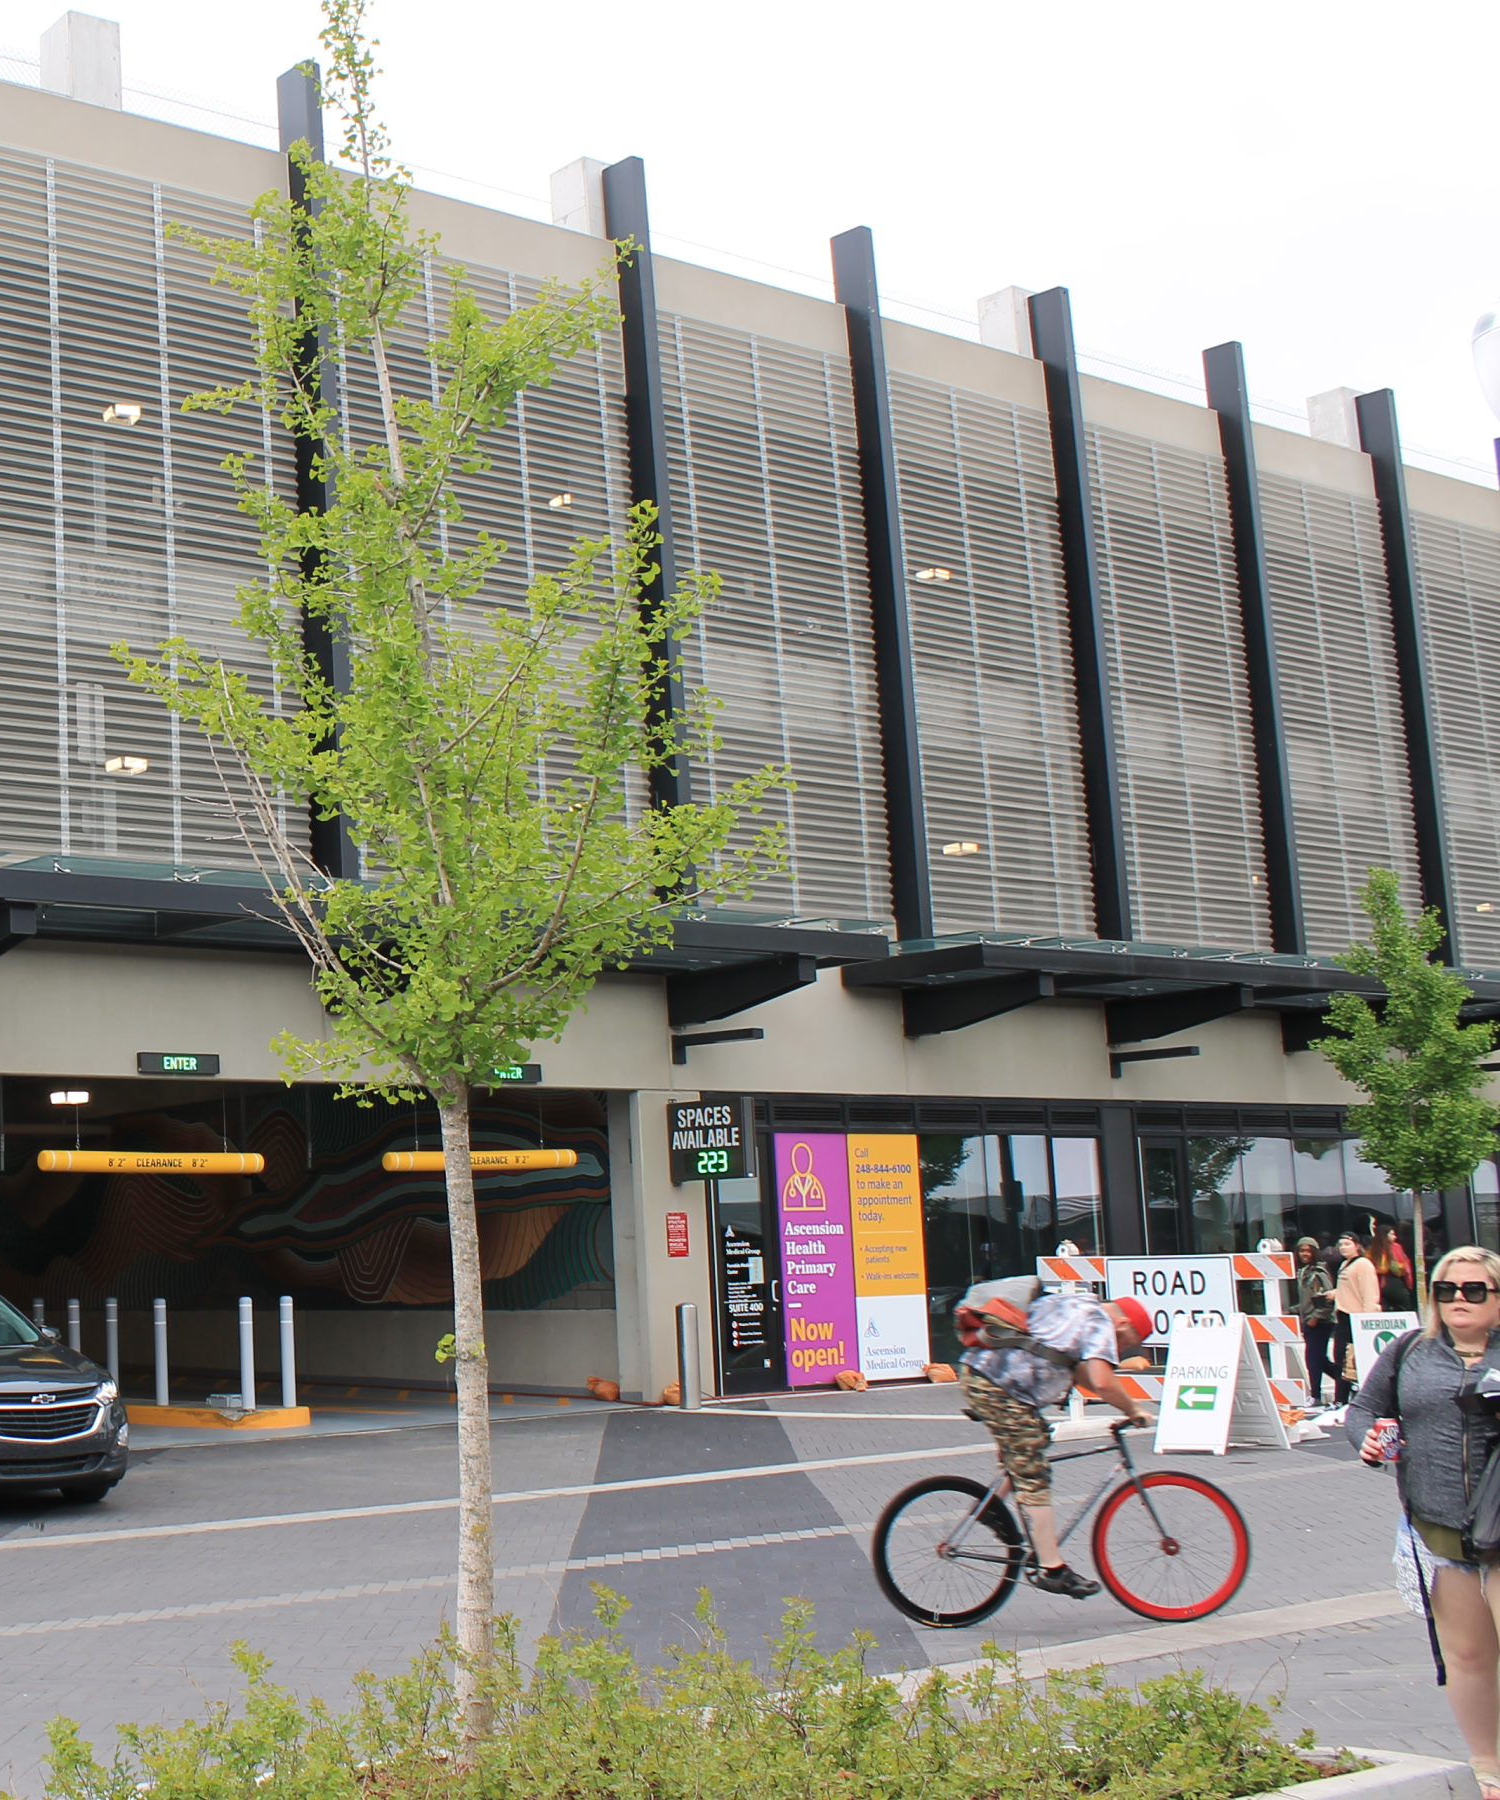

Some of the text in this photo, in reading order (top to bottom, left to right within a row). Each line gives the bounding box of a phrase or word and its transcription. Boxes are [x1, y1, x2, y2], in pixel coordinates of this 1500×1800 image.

[163, 1056, 197, 1071] ENTER
[677, 1105, 731, 1128] SPACES
[672, 1127, 740, 1150] AVAILABLE
[854, 1148, 869, 1158] Call
[136, 1158, 182, 1168] CLEARANCE
[470, 1156, 508, 1165] CLEARANCE
[697, 1151, 728, 1173] 223
[855, 1164, 912, 1174] 248-844-6100
[856, 1178, 903, 1189] to make an
[857, 1194, 912, 1207] appointment
[858, 1210, 885, 1223] today.
[784, 1220, 845, 1235] Ascension
[785, 1240, 827, 1255] Health
[865, 1245, 894, 1254] Accepting
[866, 1255, 890, 1264] patients
[786, 1260, 837, 1277] Primary
[866, 1271, 919, 1280] Walk-ins welcome
[787, 1280, 817, 1294] Care
[1132, 1270, 1206, 1296] ROAD
[728, 1302, 764, 1313] SUITE 400
[790, 1317, 834, 1342] Now
[1361, 1319, 1407, 1330] MERIDIAN
[791, 1341, 845, 1373] open!
[866, 1345, 906, 1356] Ascension
[866, 1358, 925, 1370] Medical Group
[1170, 1366, 1229, 1379] PARKING
